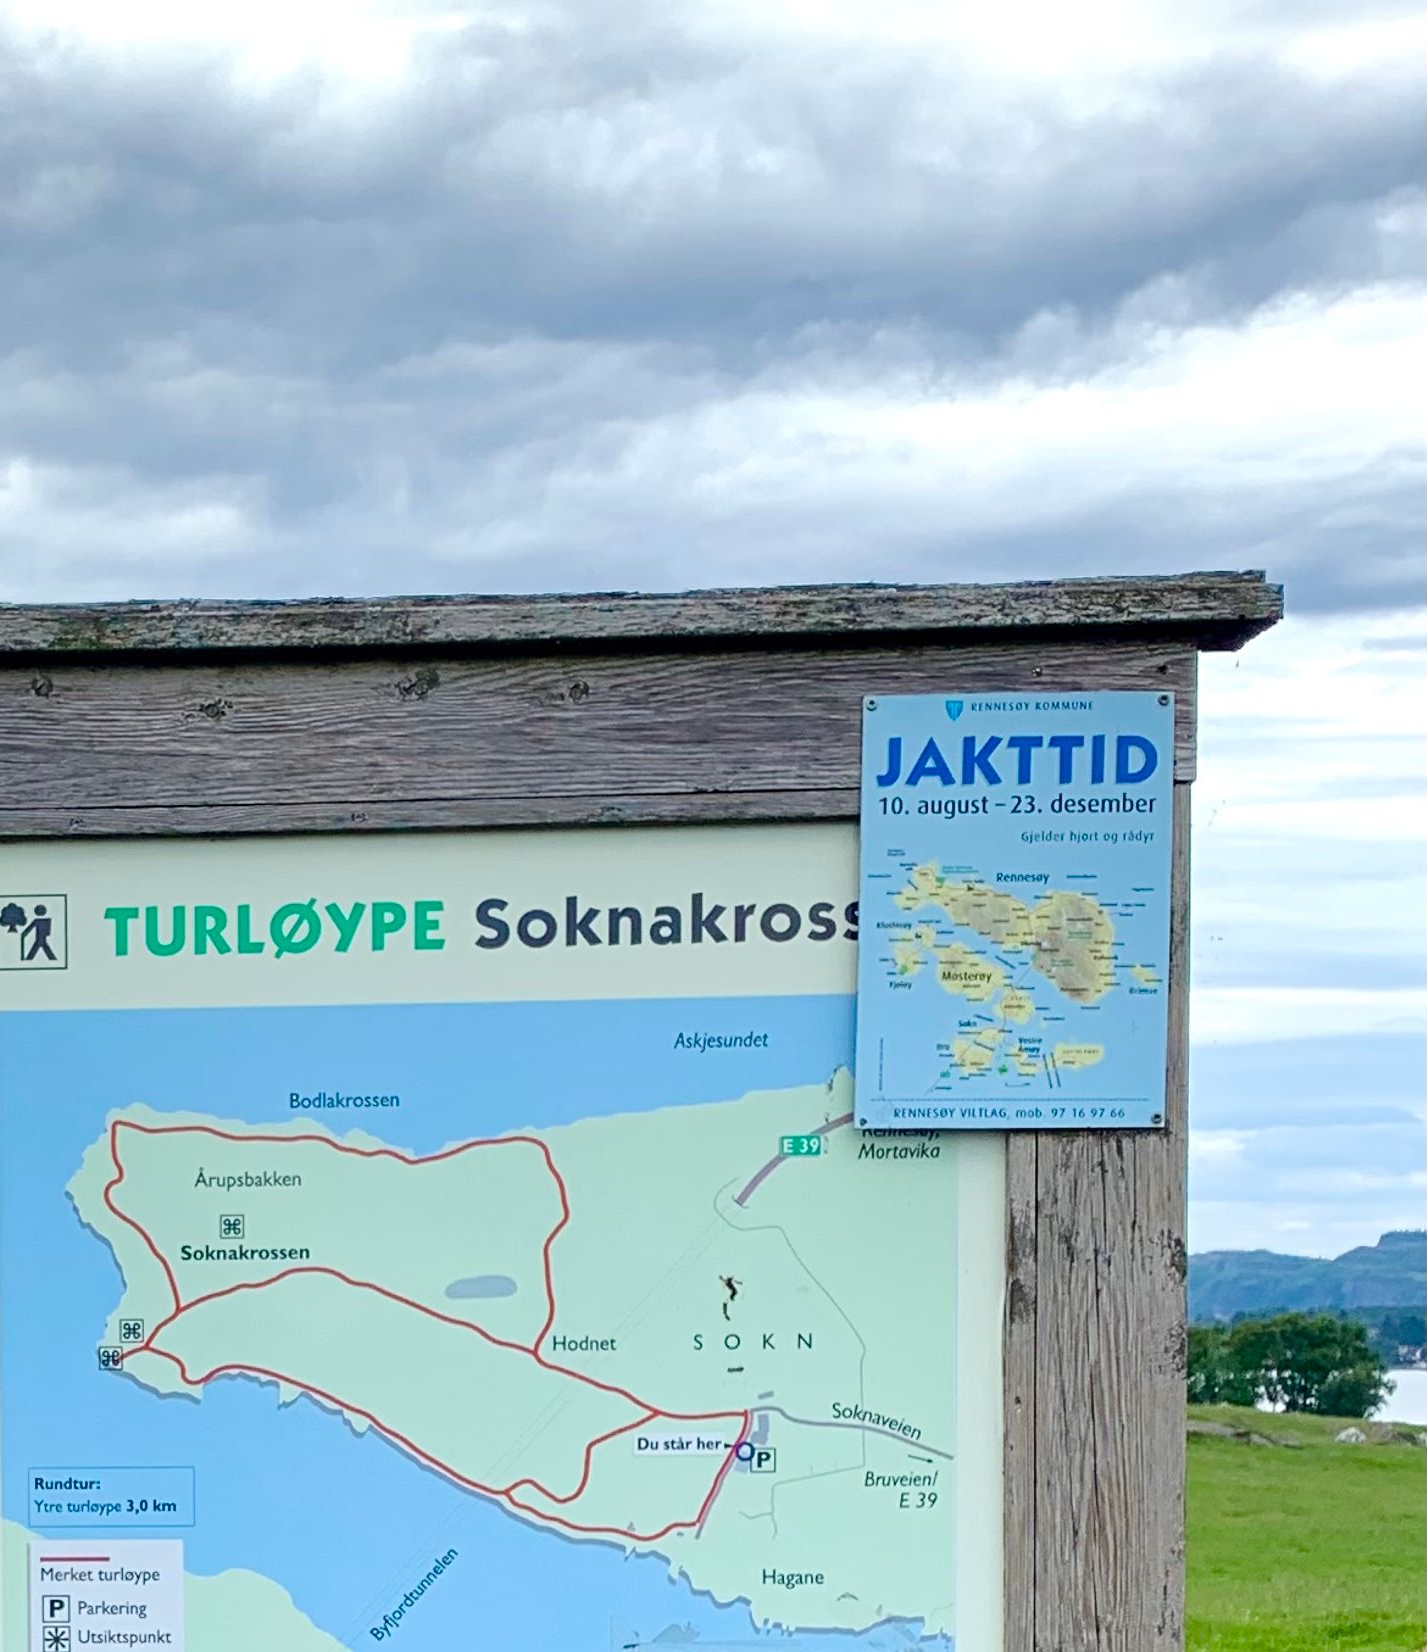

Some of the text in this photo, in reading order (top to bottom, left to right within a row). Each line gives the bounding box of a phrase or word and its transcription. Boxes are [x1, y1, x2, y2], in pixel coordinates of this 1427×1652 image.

[971, 699, 1093, 712] RENNESØY KOMMUNE
[876, 734, 1159, 787] JAKTTID
[879, 797, 910, 815] 10.
[917, 796, 989, 820] august
[1010, 796, 1044, 814] 23.
[1051, 794, 1157, 814] desember
[1021, 830, 1155, 844] Gjelder hjort og rådyr
[996, 871, 1050, 885] Rennesøy
[104, 898, 446, 959] TURLØYPE
[941, 970, 992, 984] Mosterøy
[673, 1032, 769, 1053] Askjesundet
[289, 1092, 401, 1109] Bodlakrossen
[893, 1107, 1126, 1120] RENNESØY VILTLAG, mob. 97 16 97 66
[783, 1138, 820, 1154] E 39
[857, 1142, 941, 1160] Mortavika
[194, 1167, 302, 1191] Årupsbakken
[181, 1244, 311, 1262] Soknakrossen
[552, 1335, 617, 1352] Hodnet
[832, 1402, 922, 1440] Soknaveien
[637, 1435, 722, 1451] Du står her
[756, 1452, 771, 1468] P
[34, 1477, 101, 1491] Rundtur:
[864, 1471, 938, 1488] Bruveien/
[34, 1499, 177, 1516] Ytre turløype 3,0 km
[899, 1492, 938, 1509] E 39
[40, 1567, 160, 1585] Merket turløype
[762, 1569, 825, 1589] Hagane
[369, 1546, 459, 1642] Byfjordtunnelen
[49, 1599, 148, 1619] P Parkering
[77, 1630, 172, 1648] Utsiktspunkt
